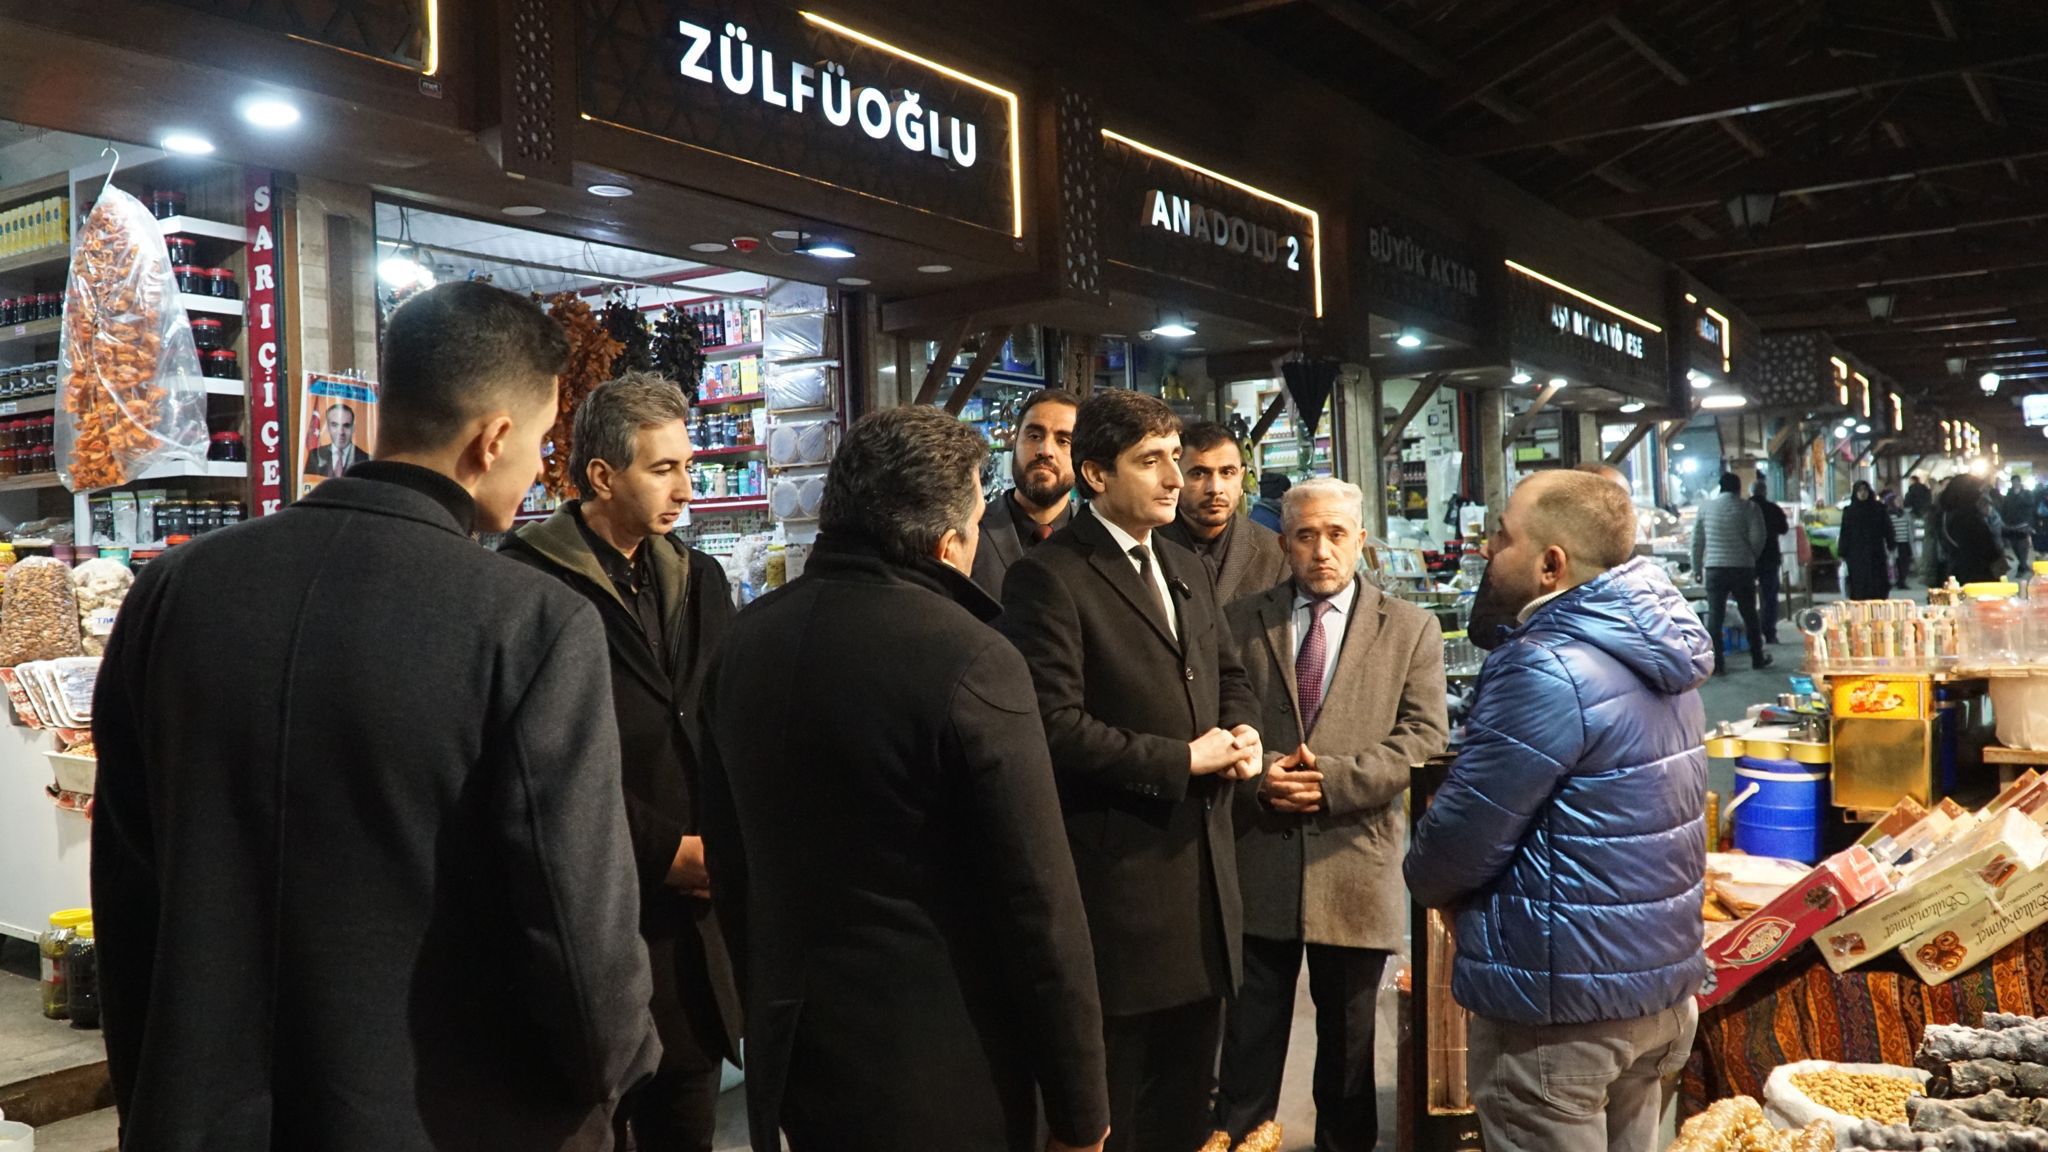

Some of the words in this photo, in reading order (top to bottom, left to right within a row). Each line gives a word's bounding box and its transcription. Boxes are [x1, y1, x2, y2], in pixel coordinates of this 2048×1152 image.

[679, 20, 976, 168] ZÜLFÜOĞLU
[1150, 190, 1278, 263] ANADOLU
[1286, 235, 1300, 271] 2
[1369, 226, 1426, 277] BÜYÜK
[1430, 253, 1478, 297] AKTAR
[1884, 890, 1970, 941] Sultanahmet
